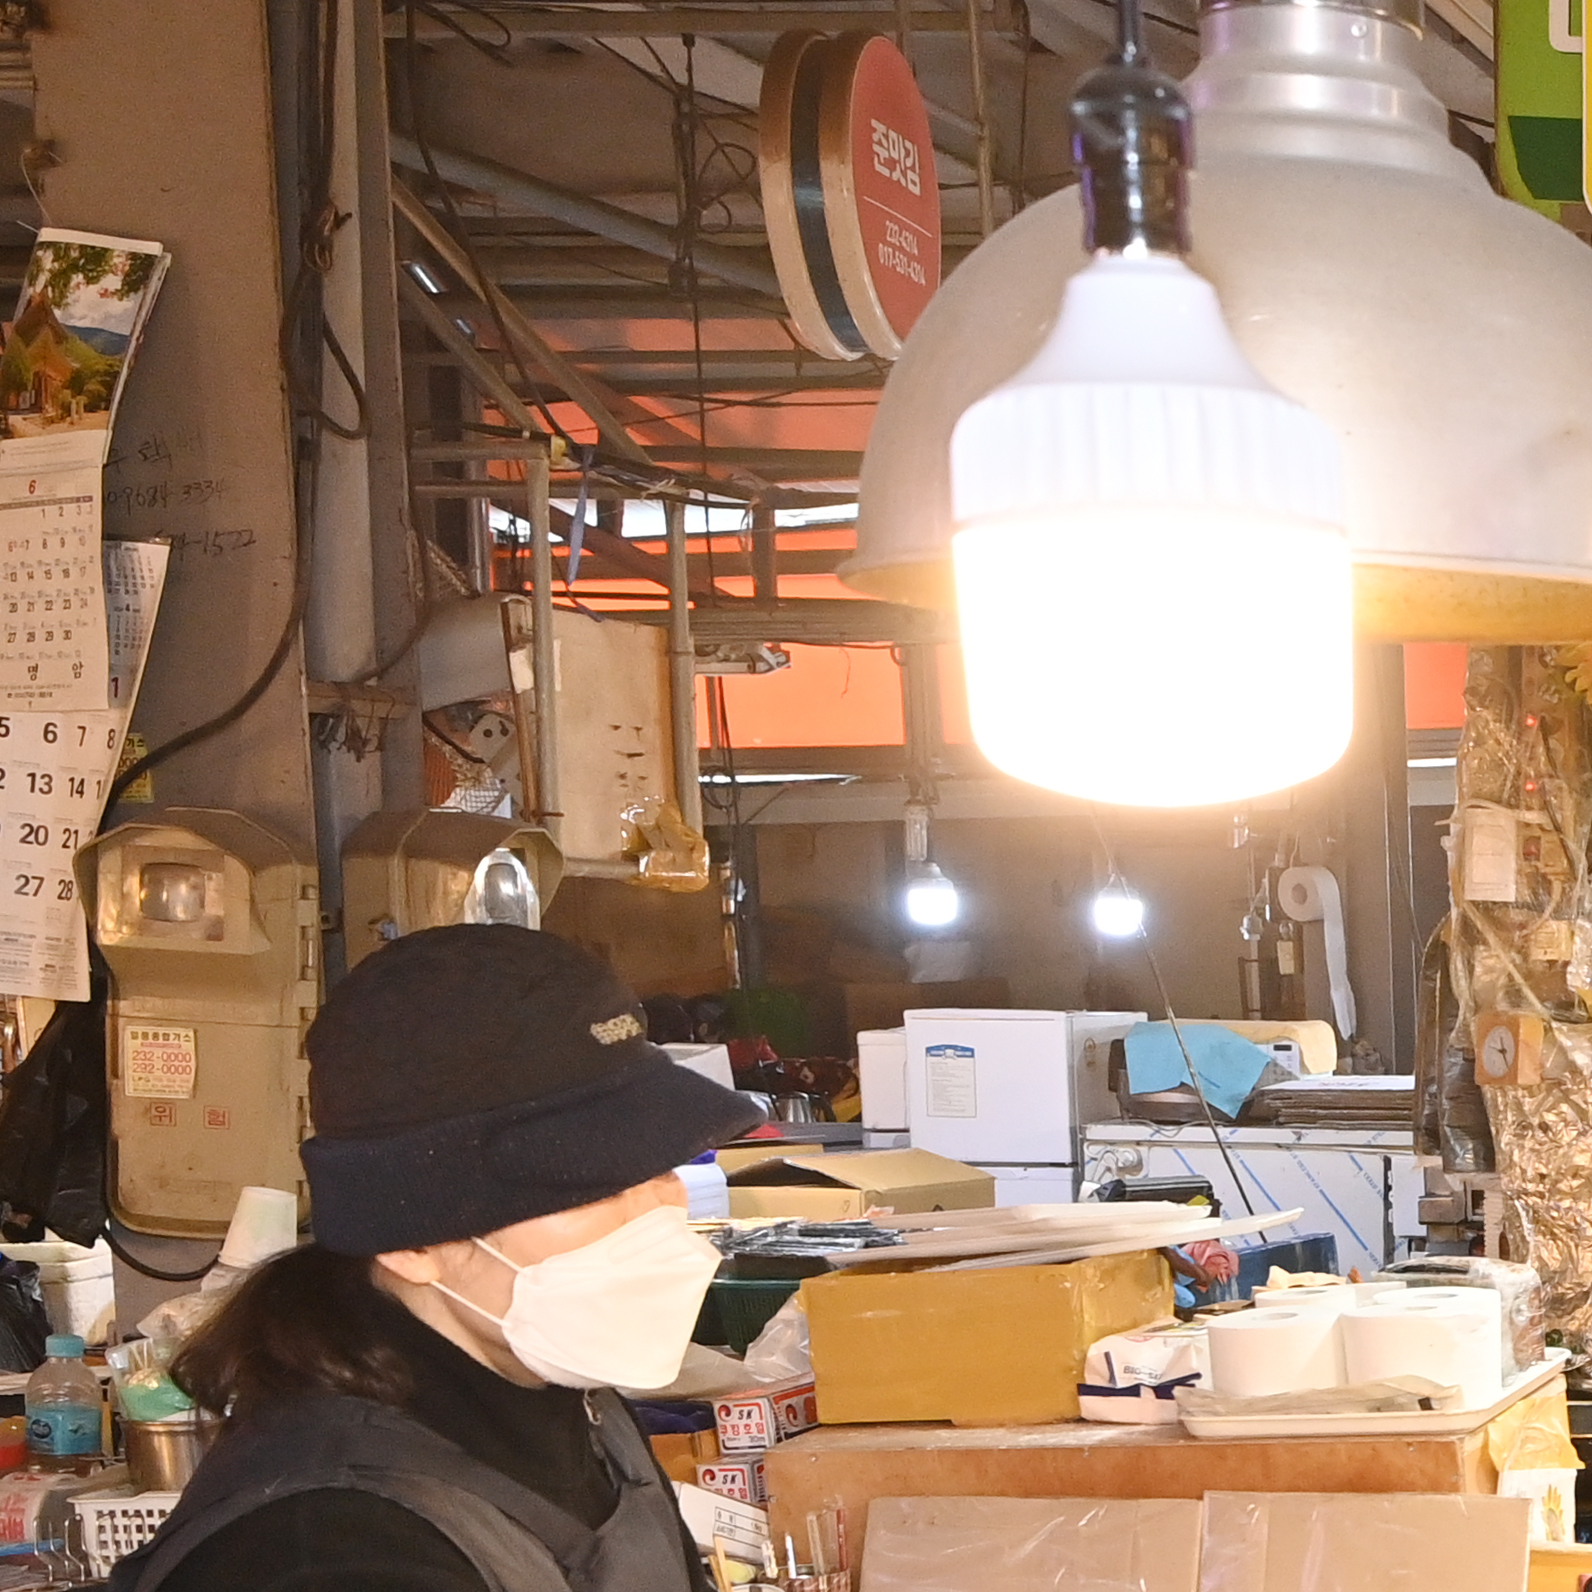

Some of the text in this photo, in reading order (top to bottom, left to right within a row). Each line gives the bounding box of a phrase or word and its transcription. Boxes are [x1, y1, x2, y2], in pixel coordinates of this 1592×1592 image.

[871, 118, 921, 197] 준맛김
[28, 479, 37, 495] 6
[42, 722, 58, 744] 6
[76, 725, 87, 747] 7
[107, 728, 116, 750] 8
[26, 772, 54, 796] 13
[68, 777, 85, 799] 14
[19, 823, 79, 849] 20 21
[14, 874, 74, 901] 27 28
[132, 1050, 192, 1063] 232-0000
[132, 1062, 192, 1075] 292-0000
[738, 1408, 754, 1420] SK
[719, 1422, 765, 1437] 쿠킹호일
[722, 1473, 738, 1485] SK
